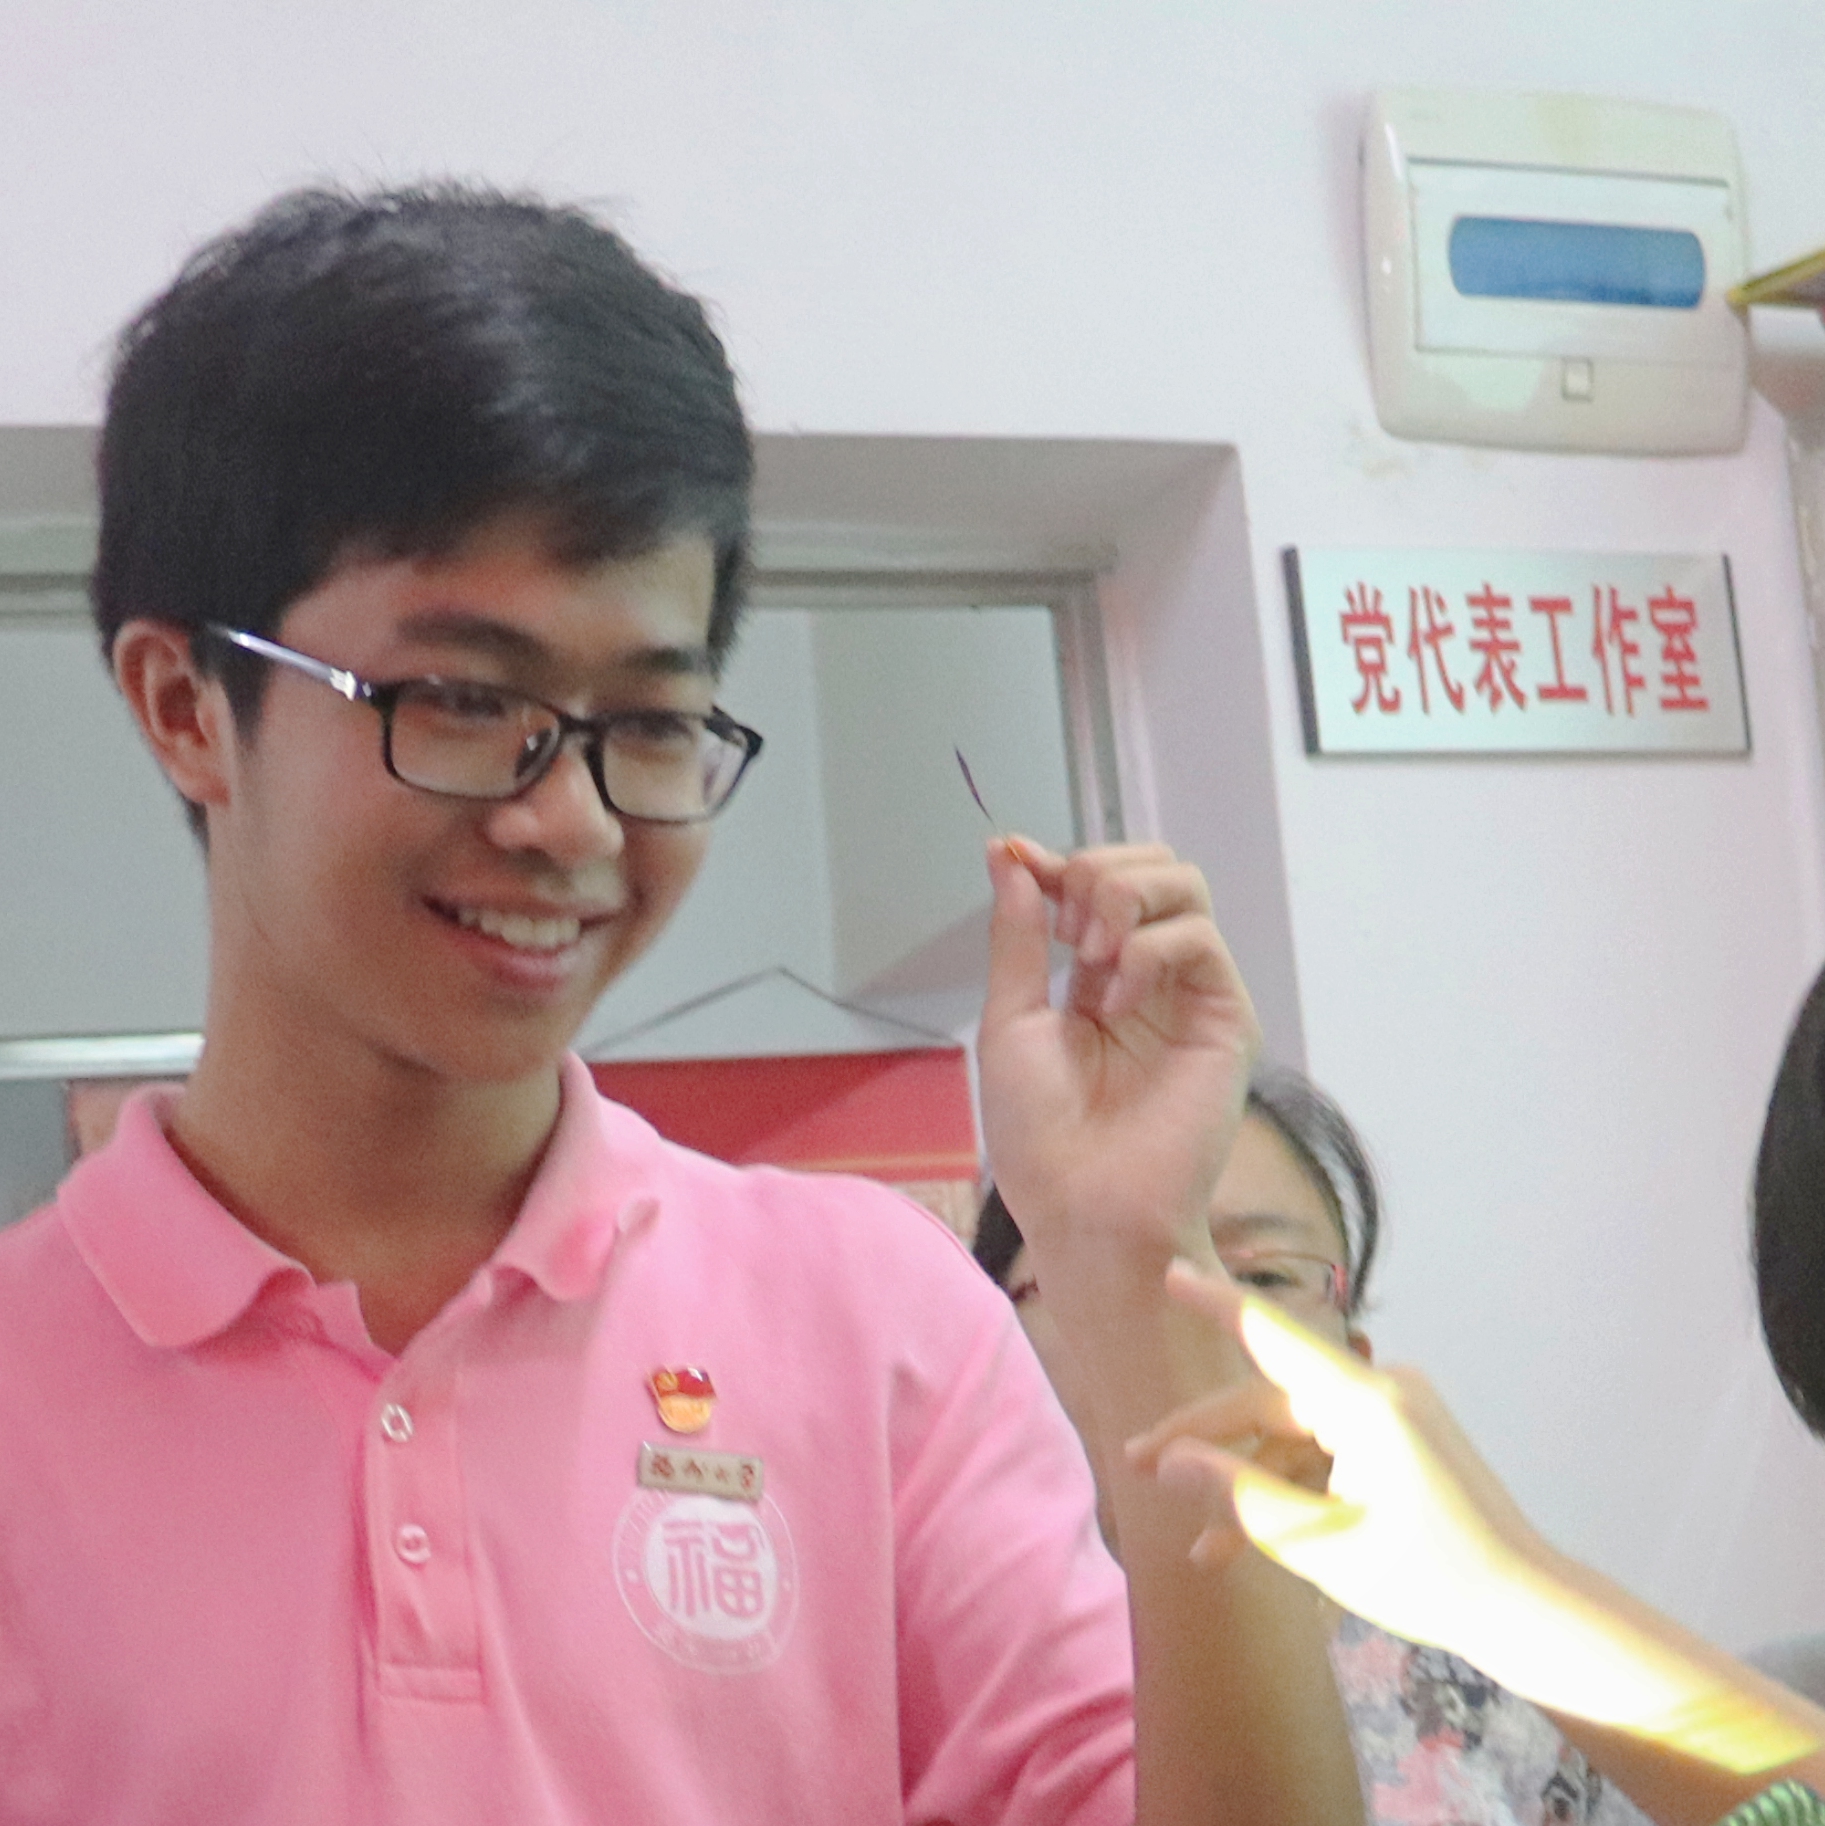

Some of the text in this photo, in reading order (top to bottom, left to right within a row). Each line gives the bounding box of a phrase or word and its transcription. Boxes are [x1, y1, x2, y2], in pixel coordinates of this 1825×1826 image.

[1337, 580, 1710, 718] 党代表工作室
[662, 1518, 767, 1619] 福
